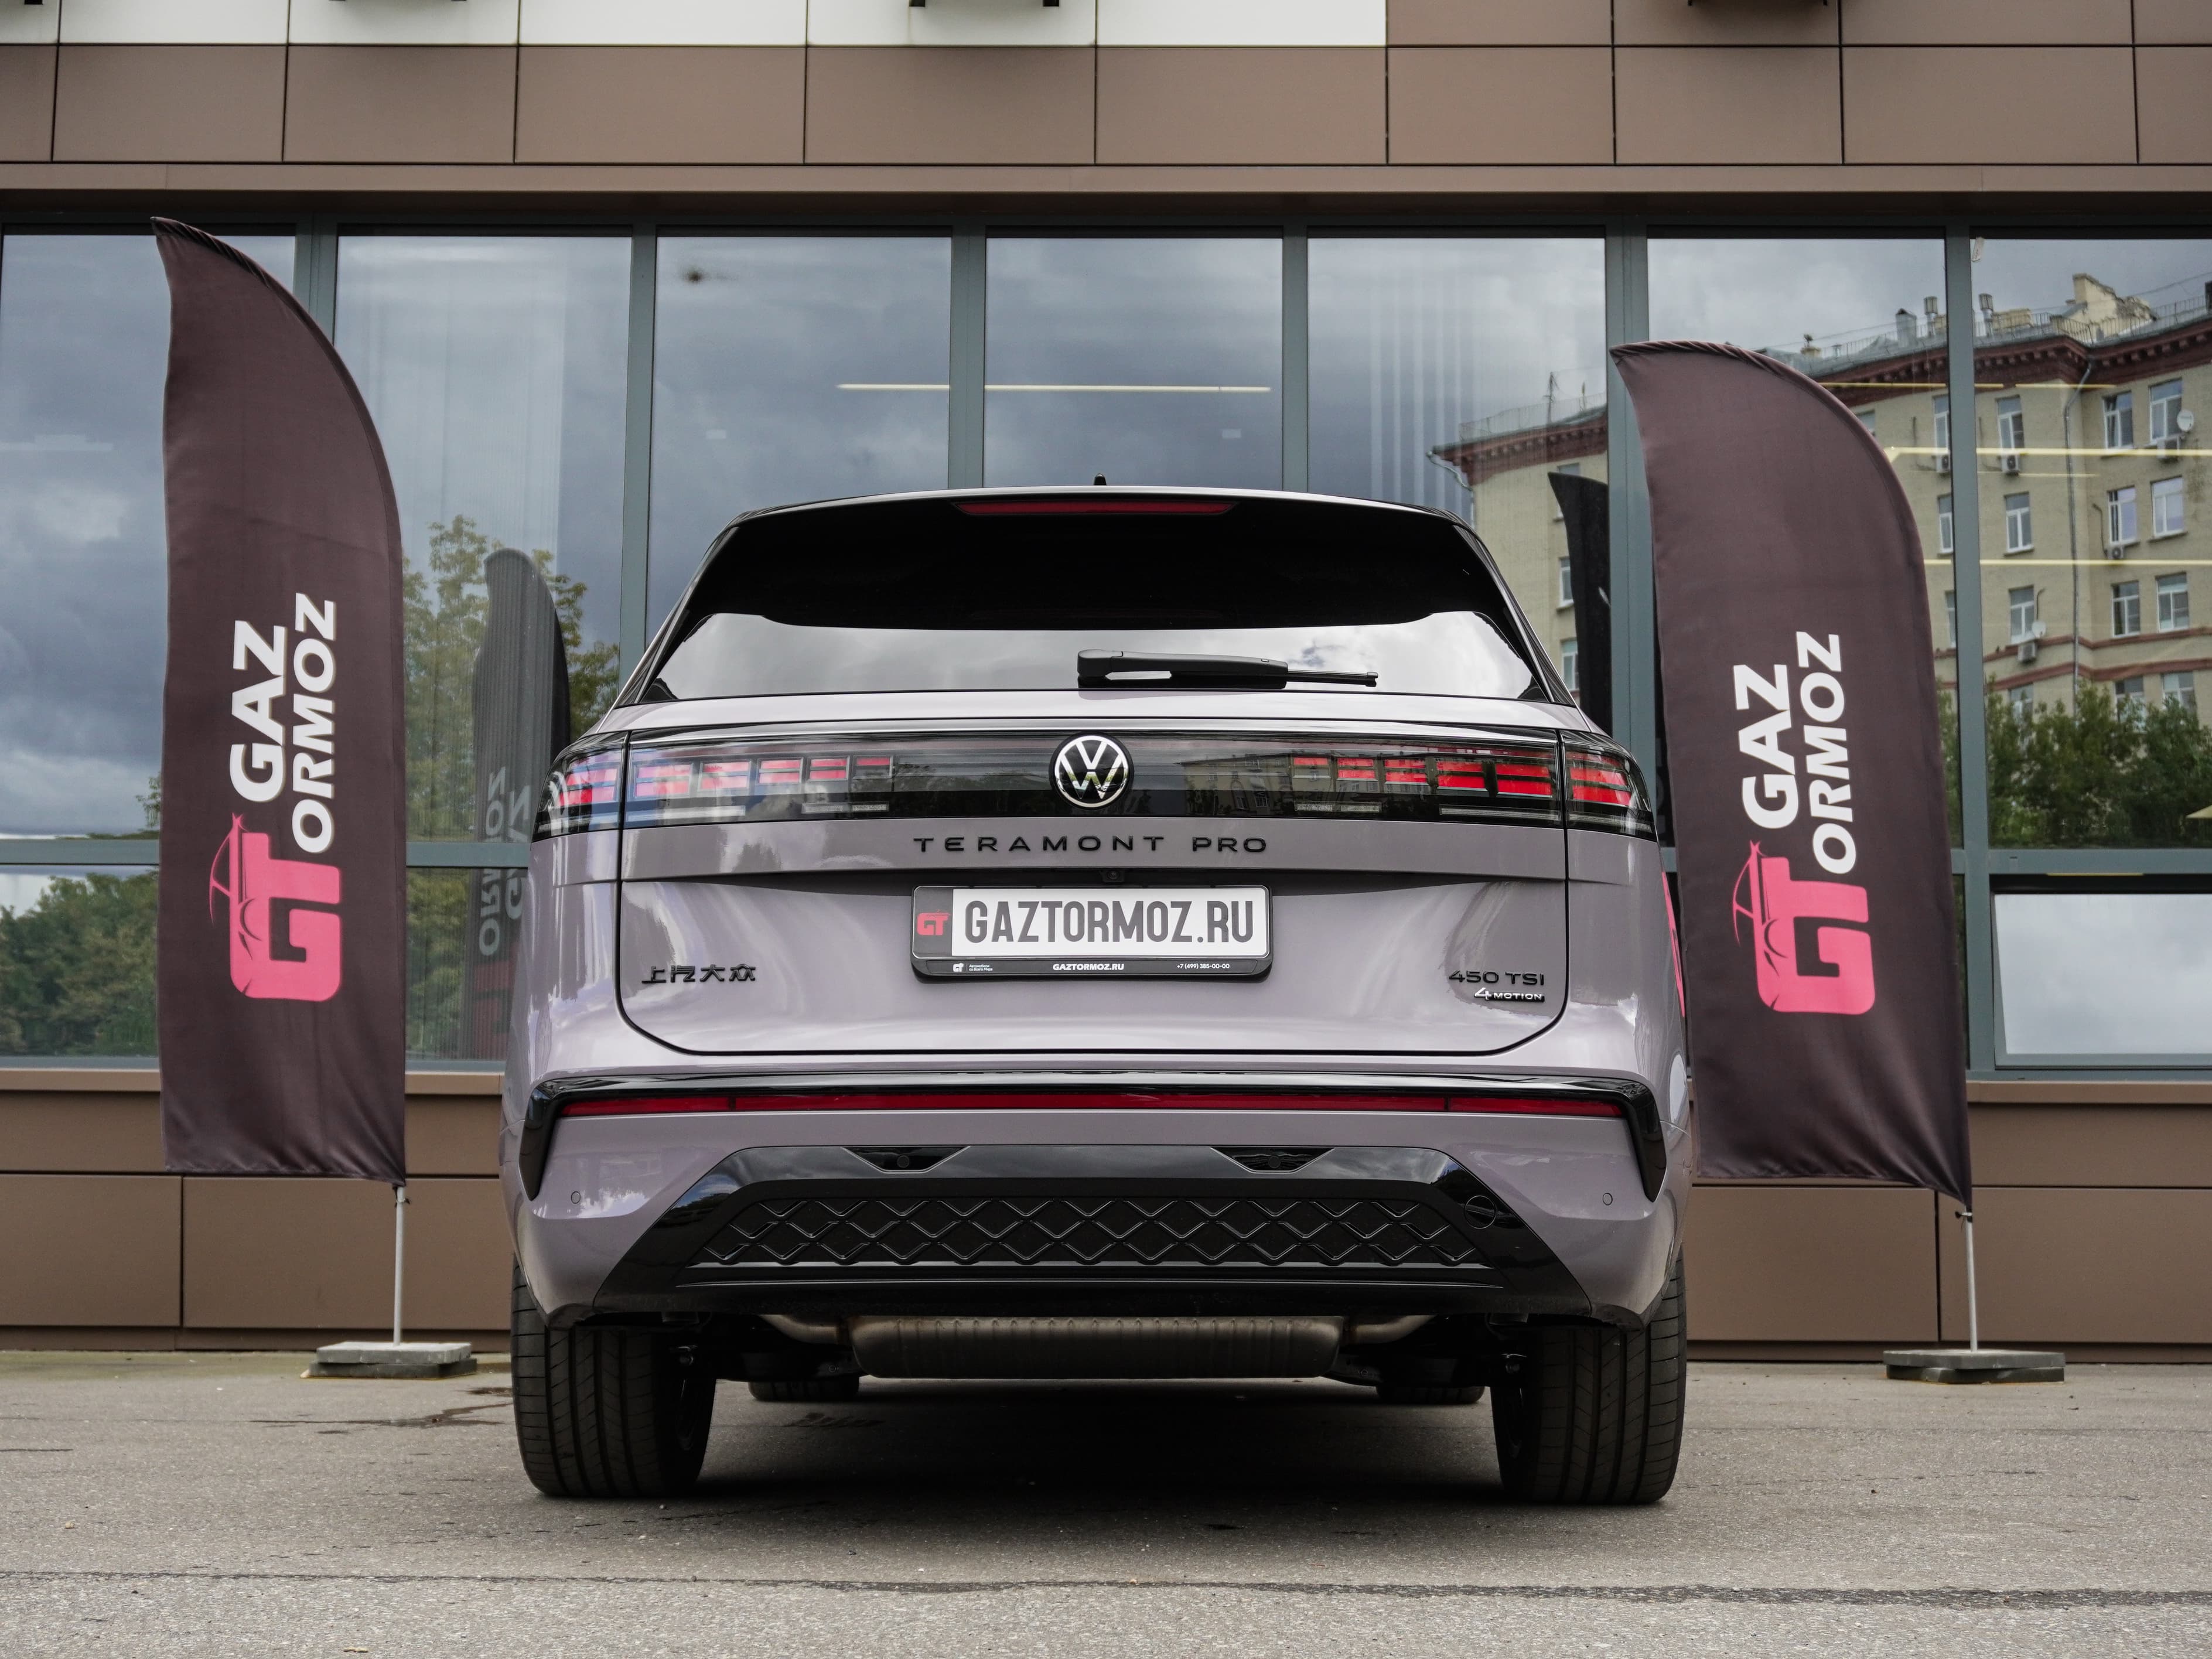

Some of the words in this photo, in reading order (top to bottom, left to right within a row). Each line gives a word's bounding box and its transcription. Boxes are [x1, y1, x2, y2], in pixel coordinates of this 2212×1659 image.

[230, 620, 286, 802] GAZ
[292, 593, 336, 853] ORMOZ
[1733, 664, 1798, 828] GAZ
[1796, 631, 1856, 873] ORMOZ
[229, 820, 341, 1002] GT
[914, 836, 1164, 852] TERAMONT
[1192, 837, 1267, 852] PRO
[917, 912, 949, 936] GT
[965, 900, 1253, 943] GAZTORMOZ.RU
[642, 964, 756, 983] 上汽大众
[1449, 970, 1499, 984] 450
[1505, 972, 1544, 985] TSI
[1749, 844, 1875, 1015] GT
